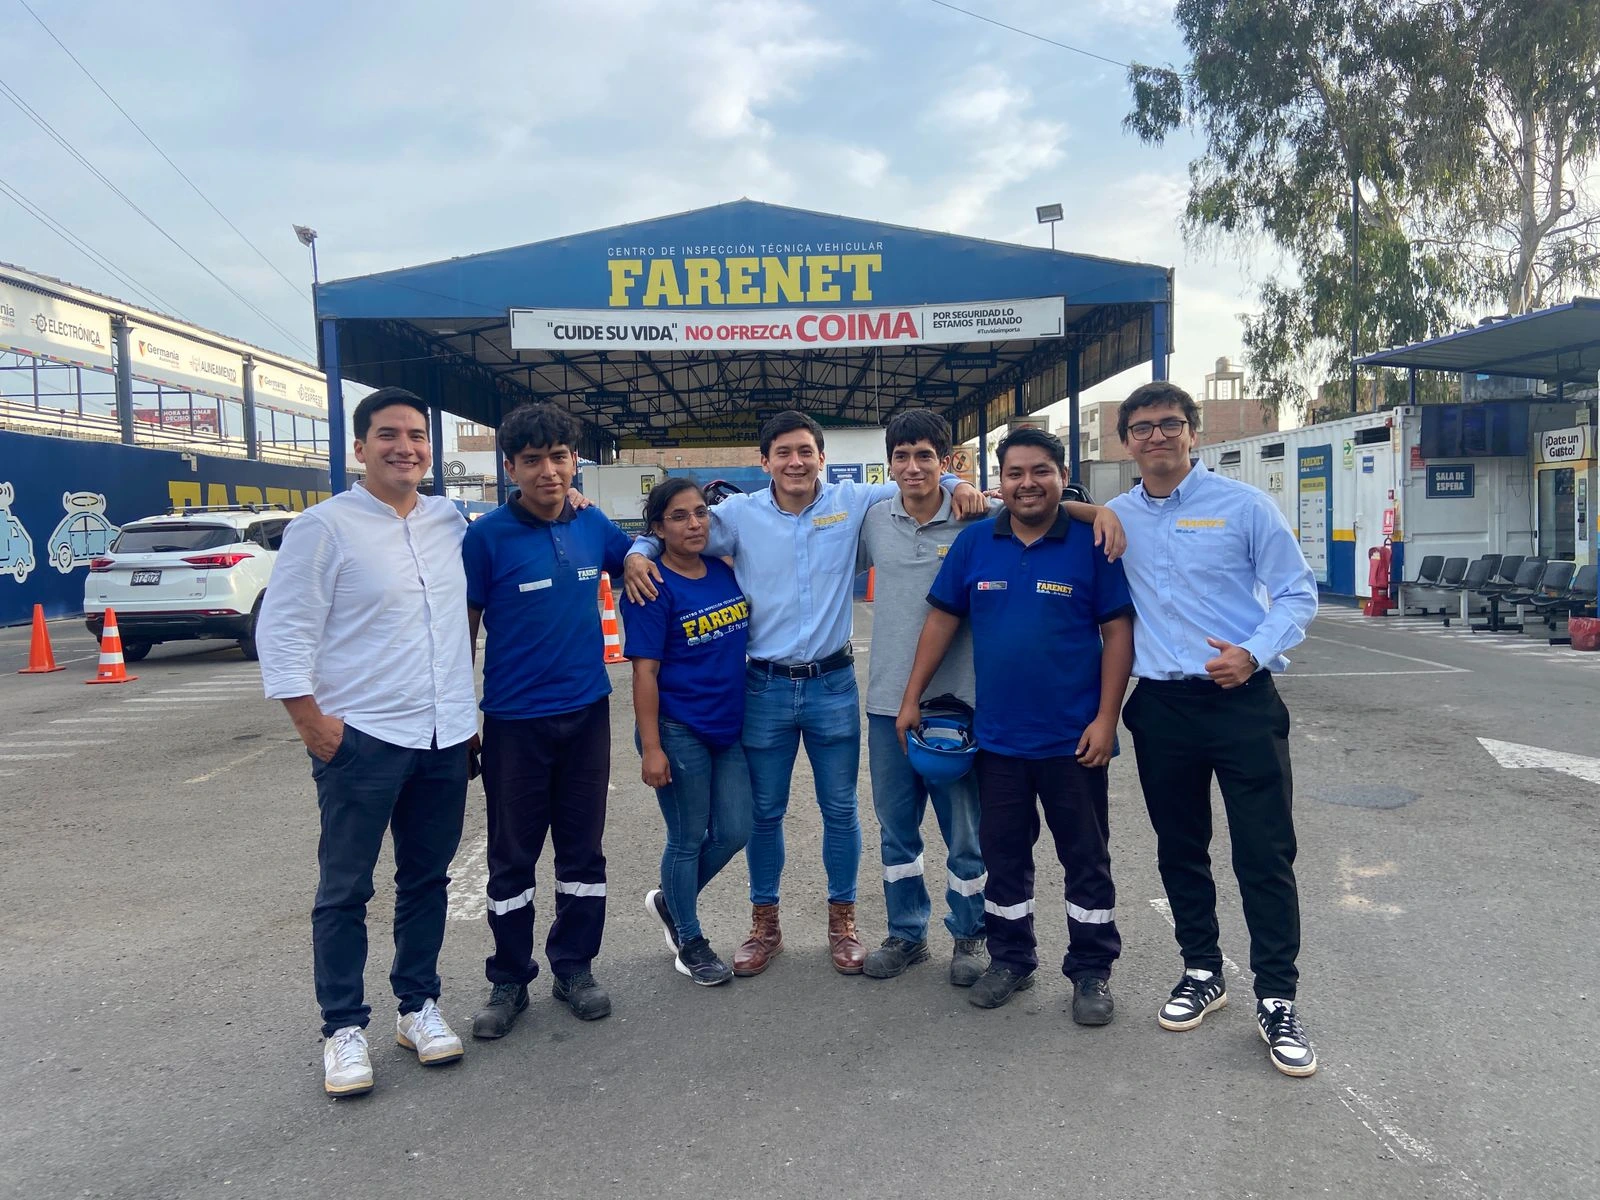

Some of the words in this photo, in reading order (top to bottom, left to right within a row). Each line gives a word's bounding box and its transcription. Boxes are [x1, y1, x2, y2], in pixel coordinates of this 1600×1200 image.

[607, 247, 655, 256] CENTRO
[661, 246, 676, 255] DE
[682, 244, 755, 255] INSPECCIÓN
[760, 243, 812, 254] TÉCNICA
[817, 241, 884, 252] VEHICULAR
[607, 254, 882, 307] FARENET
[933, 312, 951, 320] POR
[952, 309, 1001, 319] SEGURIDAD
[1002, 308, 1014, 316] LO
[606, 325, 629, 341] SU
[685, 325, 714, 341] NO
[716, 324, 793, 341] OFREZCA
[796, 311, 919, 343] COIMA
[933, 319, 974, 329] ESTAMOS
[976, 316, 1023, 327] FILMANDO
[48, 318, 101, 345] ELECTRÓNICA
[147, 343, 180, 361] Germania
[201, 360, 237, 379] ALINEAMIENTO
[1545, 435, 1567, 449] ¡Date
[1568, 434, 1579, 444] un
[1549, 444, 1576, 458] Gusto!
[871, 474, 879, 485] 2
[1435, 472, 1455, 481] SALA
[1455, 472, 1465, 481] DE
[1436, 481, 1465, 491] ESPERA
[1037, 582, 1073, 594] FARENET
[682, 601, 748, 637] FARENE
